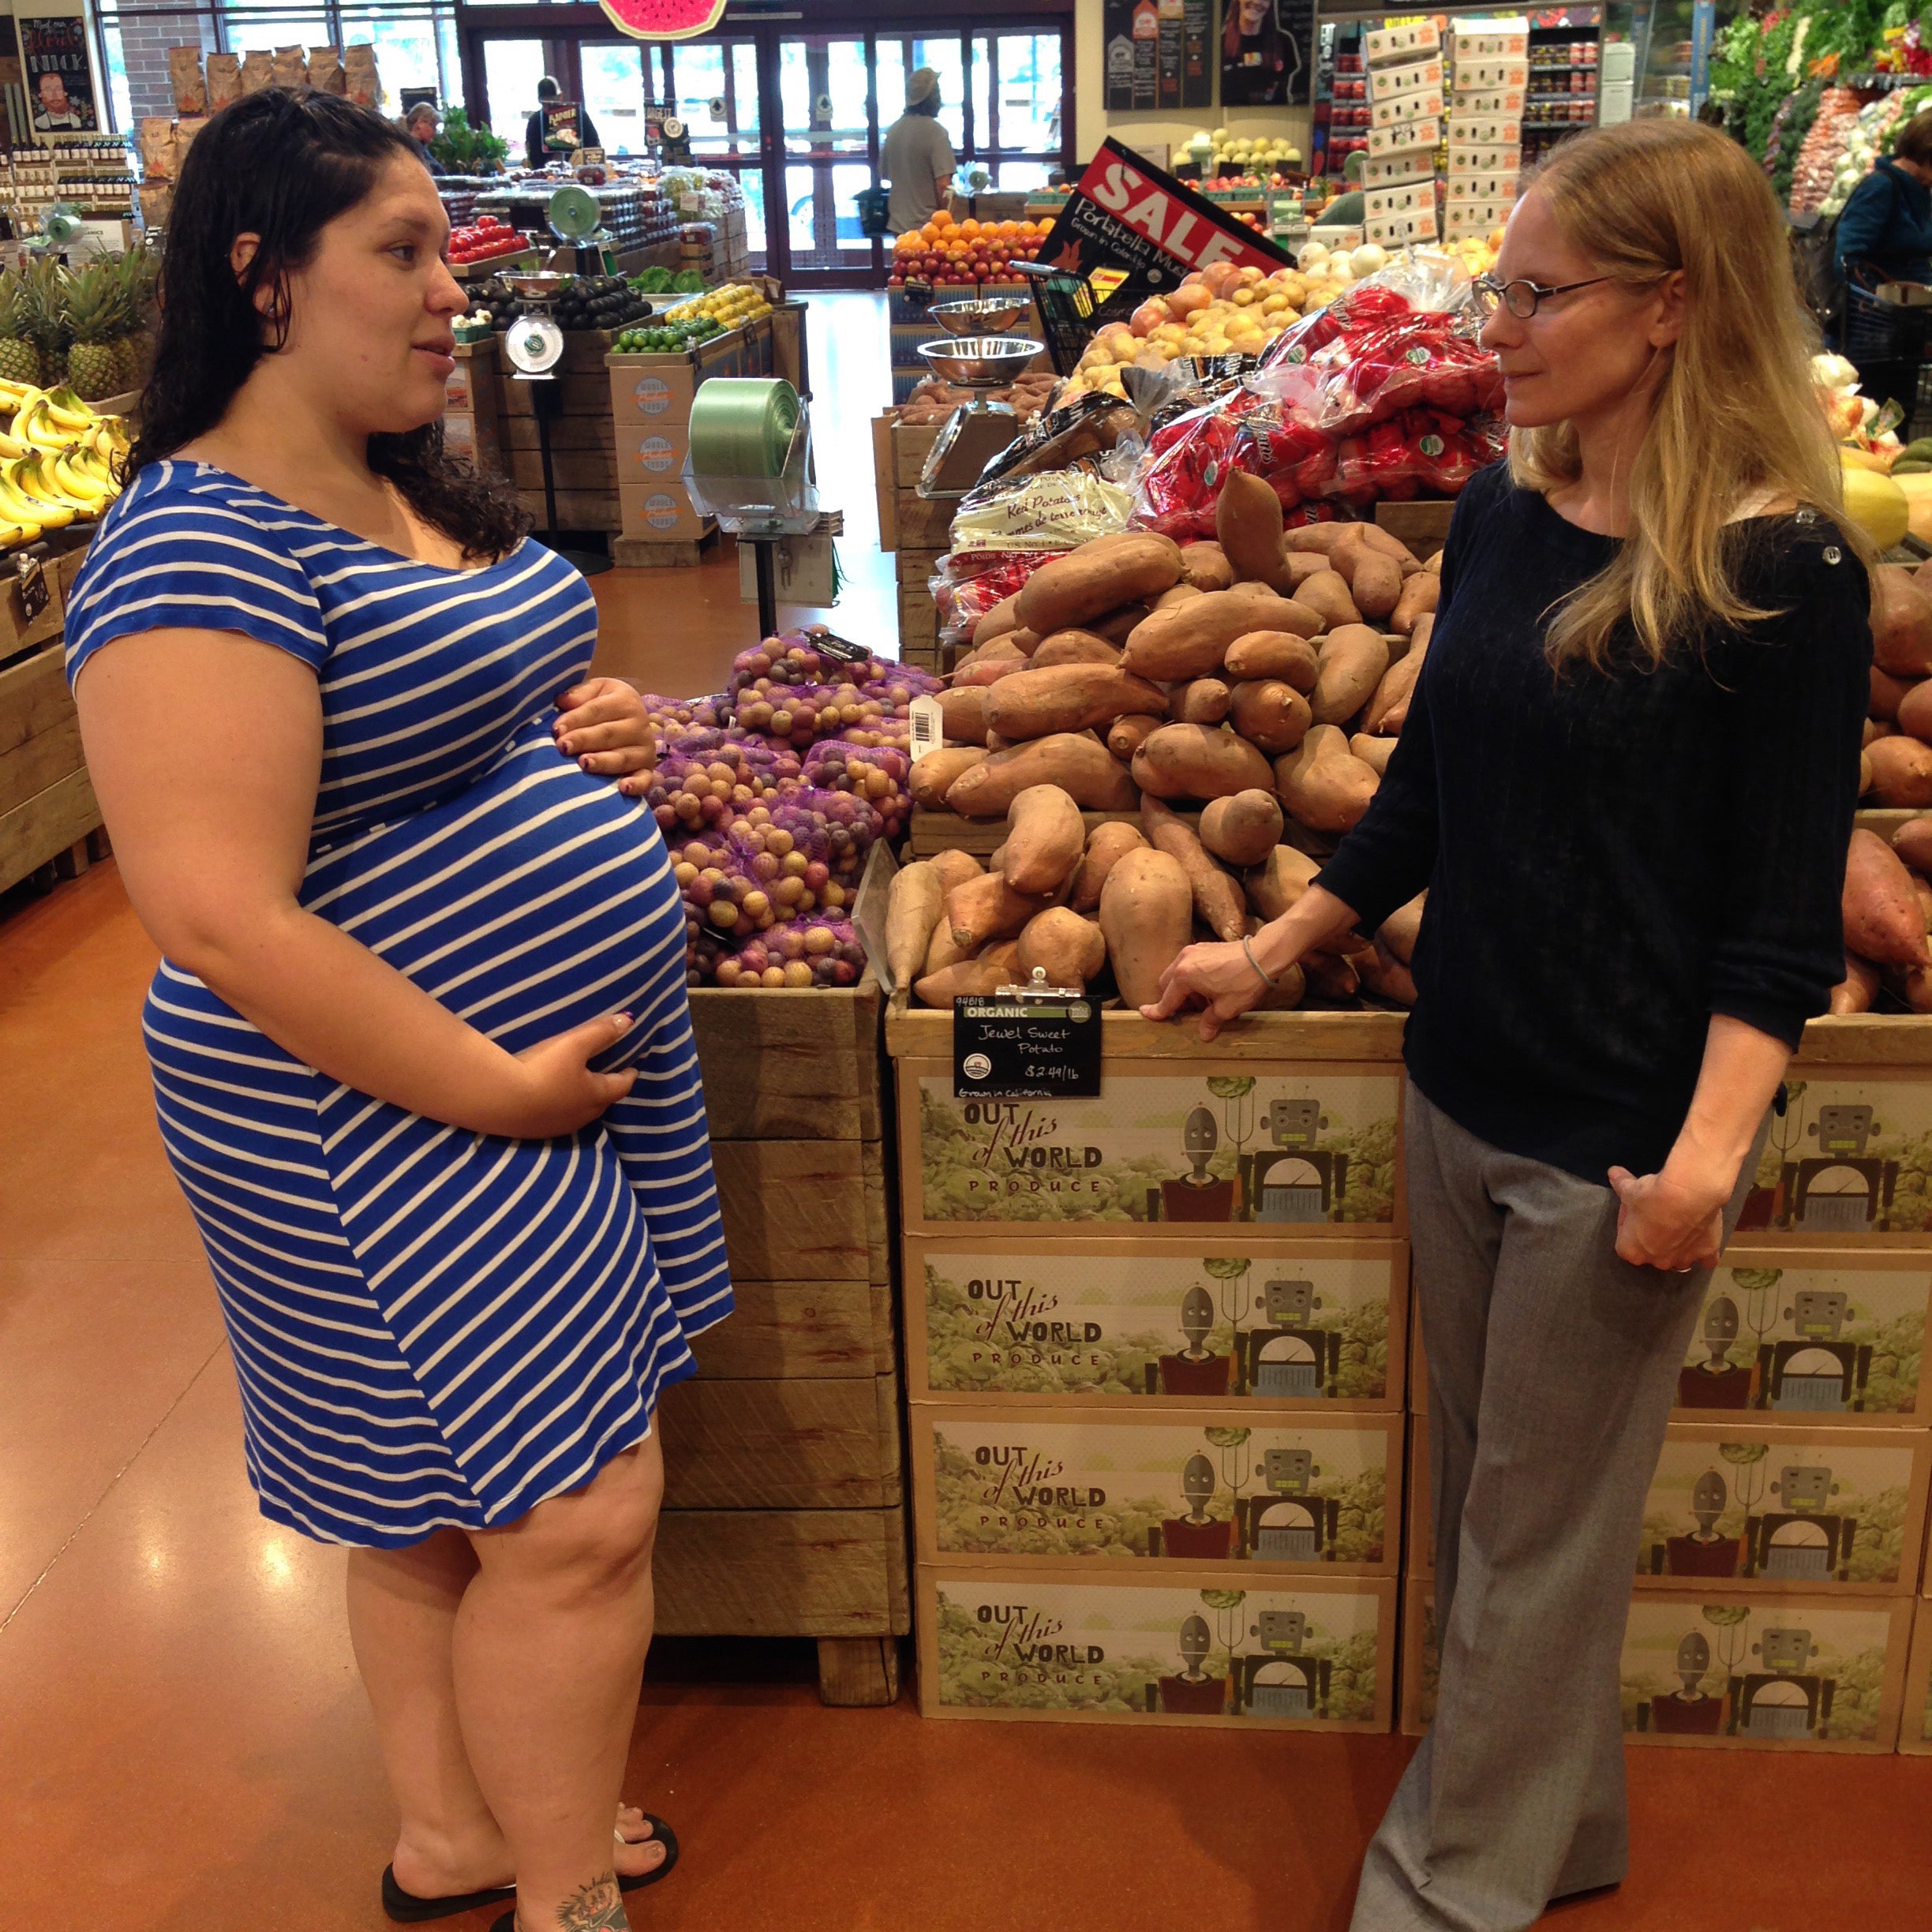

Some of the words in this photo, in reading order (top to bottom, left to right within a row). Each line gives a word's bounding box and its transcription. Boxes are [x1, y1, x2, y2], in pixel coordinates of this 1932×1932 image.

[1074, 197, 1151, 256] Portabella
[1092, 163, 1245, 271] SALE
[1007, 498, 1028, 519] Red
[1035, 510, 1048, 527] de
[1050, 511, 1076, 522] terre
[967, 1007, 1028, 1017] ORGANIC
[978, 1024, 1023, 1041] Jewel
[1027, 1027, 1071, 1040] Sweet
[1017, 1043, 1064, 1054] Potato
[958, 1088, 992, 1098] Grown
[1005, 1088, 1052, 1098] California
[964, 1103, 1020, 1125] OUT
[972, 1115, 1009, 1167] of
[1010, 1110, 1058, 1148] this
[1003, 1147, 1103, 1168] WORLD
[968, 1181, 1099, 1192] PRODUCE
[968, 1279, 1022, 1301] OUT
[975, 1291, 1012, 1341] of
[1012, 1286, 1058, 1322] this
[1005, 1321, 1102, 1343] WORLD
[972, 1353, 1099, 1365] PRODUCE
[975, 1446, 1028, 1466] OUT
[983, 1458, 1017, 1504] of
[1018, 1453, 1064, 1487] this
[1012, 1486, 1106, 1507] WORLD
[980, 1515, 1103, 1530] PRODUCE
[977, 1604, 1028, 1624] OUT
[984, 1616, 1019, 1661] of
[1019, 1612, 1063, 1644] this
[1013, 1643, 1104, 1664] WORLD
[981, 1672, 1102, 1685] PRODUCE
